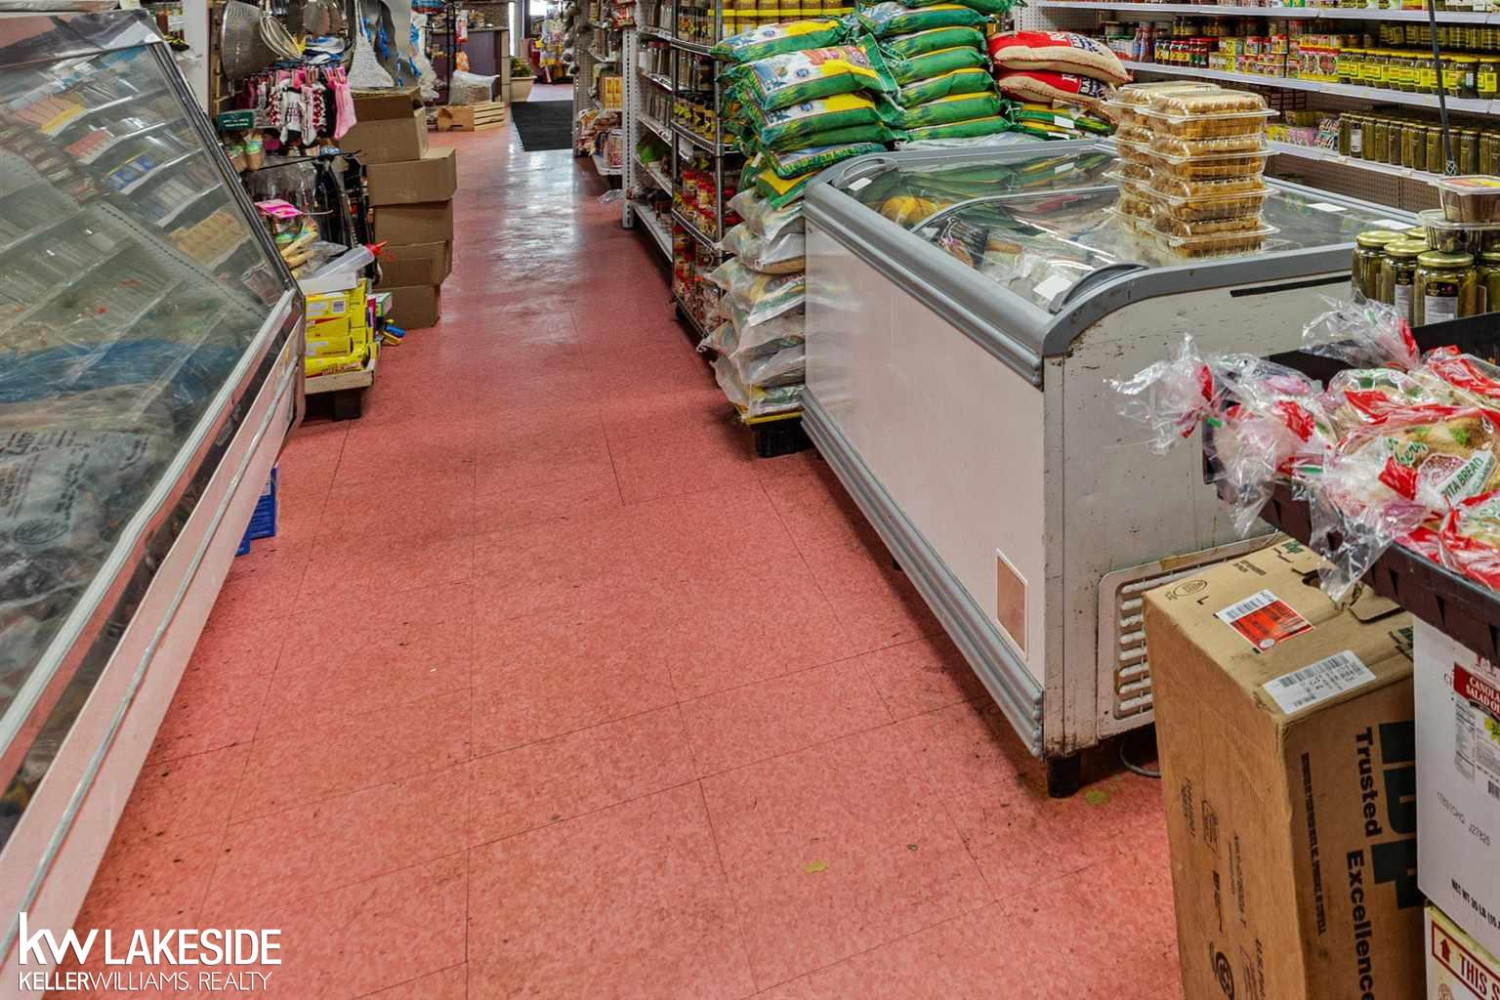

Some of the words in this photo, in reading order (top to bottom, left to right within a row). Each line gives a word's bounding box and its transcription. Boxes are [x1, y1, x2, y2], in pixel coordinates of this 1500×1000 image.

[1466, 684, 1489, 705] SALAD
[1470, 677, 1500, 702] CANOLA
[1355, 727, 1382, 838] Trusted
[1460, 953, 1487, 995] THIS
